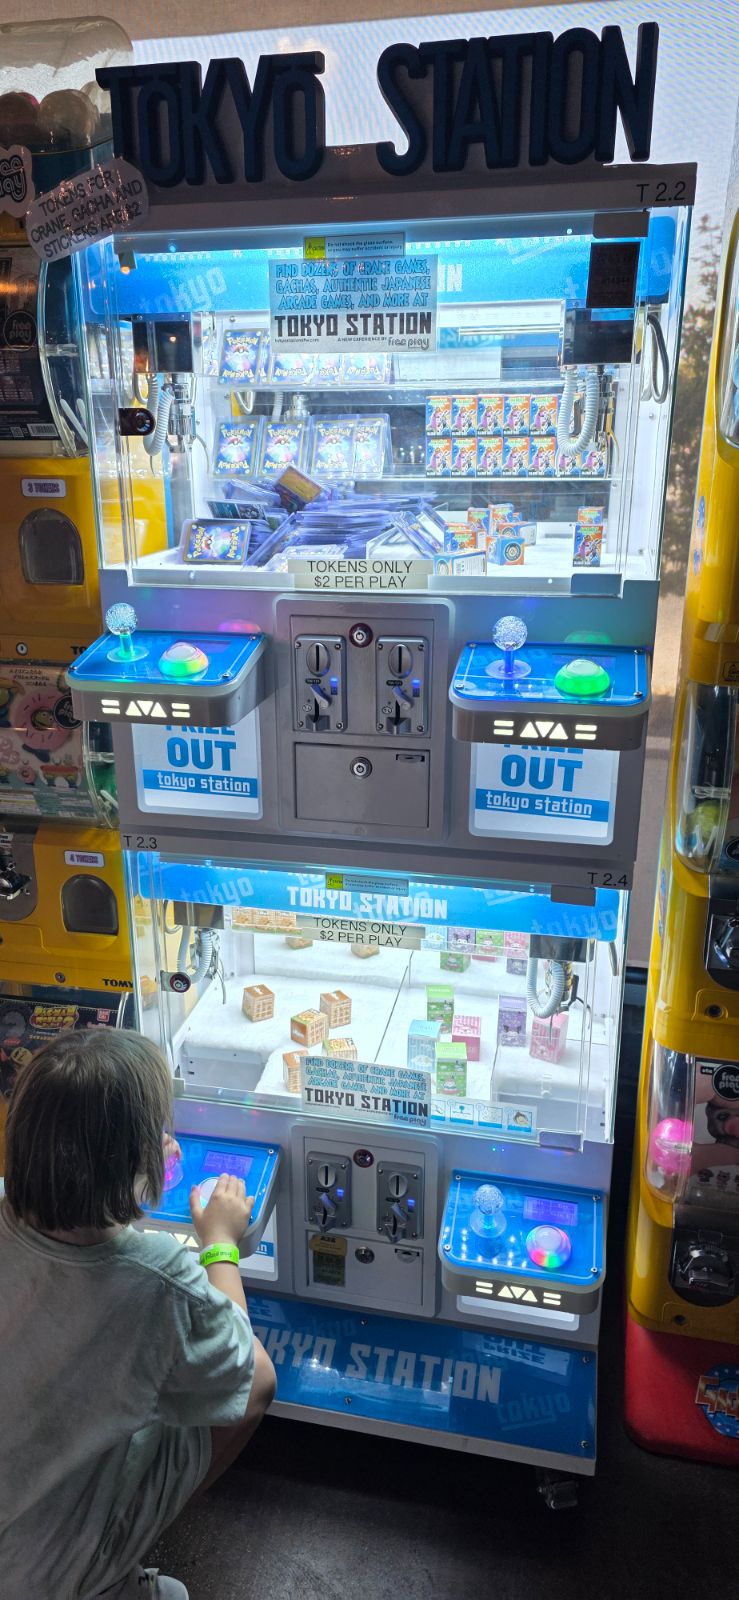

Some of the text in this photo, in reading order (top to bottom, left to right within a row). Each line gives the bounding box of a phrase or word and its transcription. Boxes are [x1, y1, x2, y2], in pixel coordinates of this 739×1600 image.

[376, 22, 659, 177] STATION
[38, 170, 115, 217] TOKENS FOR
[71, 192, 113, 221] GACHA
[112, 179, 143, 204] AND
[636, 180, 686, 204] T 2.2
[43, 201, 142, 258] STICKERS ARE $2
[275, 258, 431, 278] FIND DOZENS OF CRANE GAMES,
[275, 277, 320, 295] GACHAS,
[322, 275, 378, 293] AUTHENTIC
[381, 275, 431, 293] JAPANESE
[277, 291, 428, 310] ARCADE GAMES, AND MORE AT
[274, 311, 432, 337] TOKYO STATION
[27, 482, 34, 493] 3
[306, 560, 413, 574] TOKENS ONLY
[314, 575, 407, 589] $2 PER PLAY
[166, 736, 237, 772] OUT
[157, 771, 251, 796] tokyo station
[501, 754, 584, 793] OUT
[486, 790, 593, 819] tokyo station
[123, 835, 158, 850] T 2.3
[587, 871, 628, 887] T 2.4
[287, 885, 448, 920] TOKYO STATION
[313, 916, 408, 936] TOKENS ONLY
[319, 929, 403, 948] $2 PER PLAY
[101, 978, 134, 989] TOMY
[305, 1056, 324, 1068] FIND
[326, 1059, 355, 1073] DOZENS
[358, 1063, 369, 1073] OF
[370, 1065, 396, 1078] CRANE
[308, 1076, 339, 1089] ARCADE
[369, 1084, 388, 1095] AND
[389, 1087, 411, 1099] MORE
[412, 1091, 425, 1101] AT
[343, 1071, 386, 1086] AUTHENTIC
[388, 1076, 427, 1091] JAPANESE
[305, 1087, 355, 1107] TOKYO
[361, 1094, 429, 1118] STATION
[345, 1342, 501, 1404] STATION
